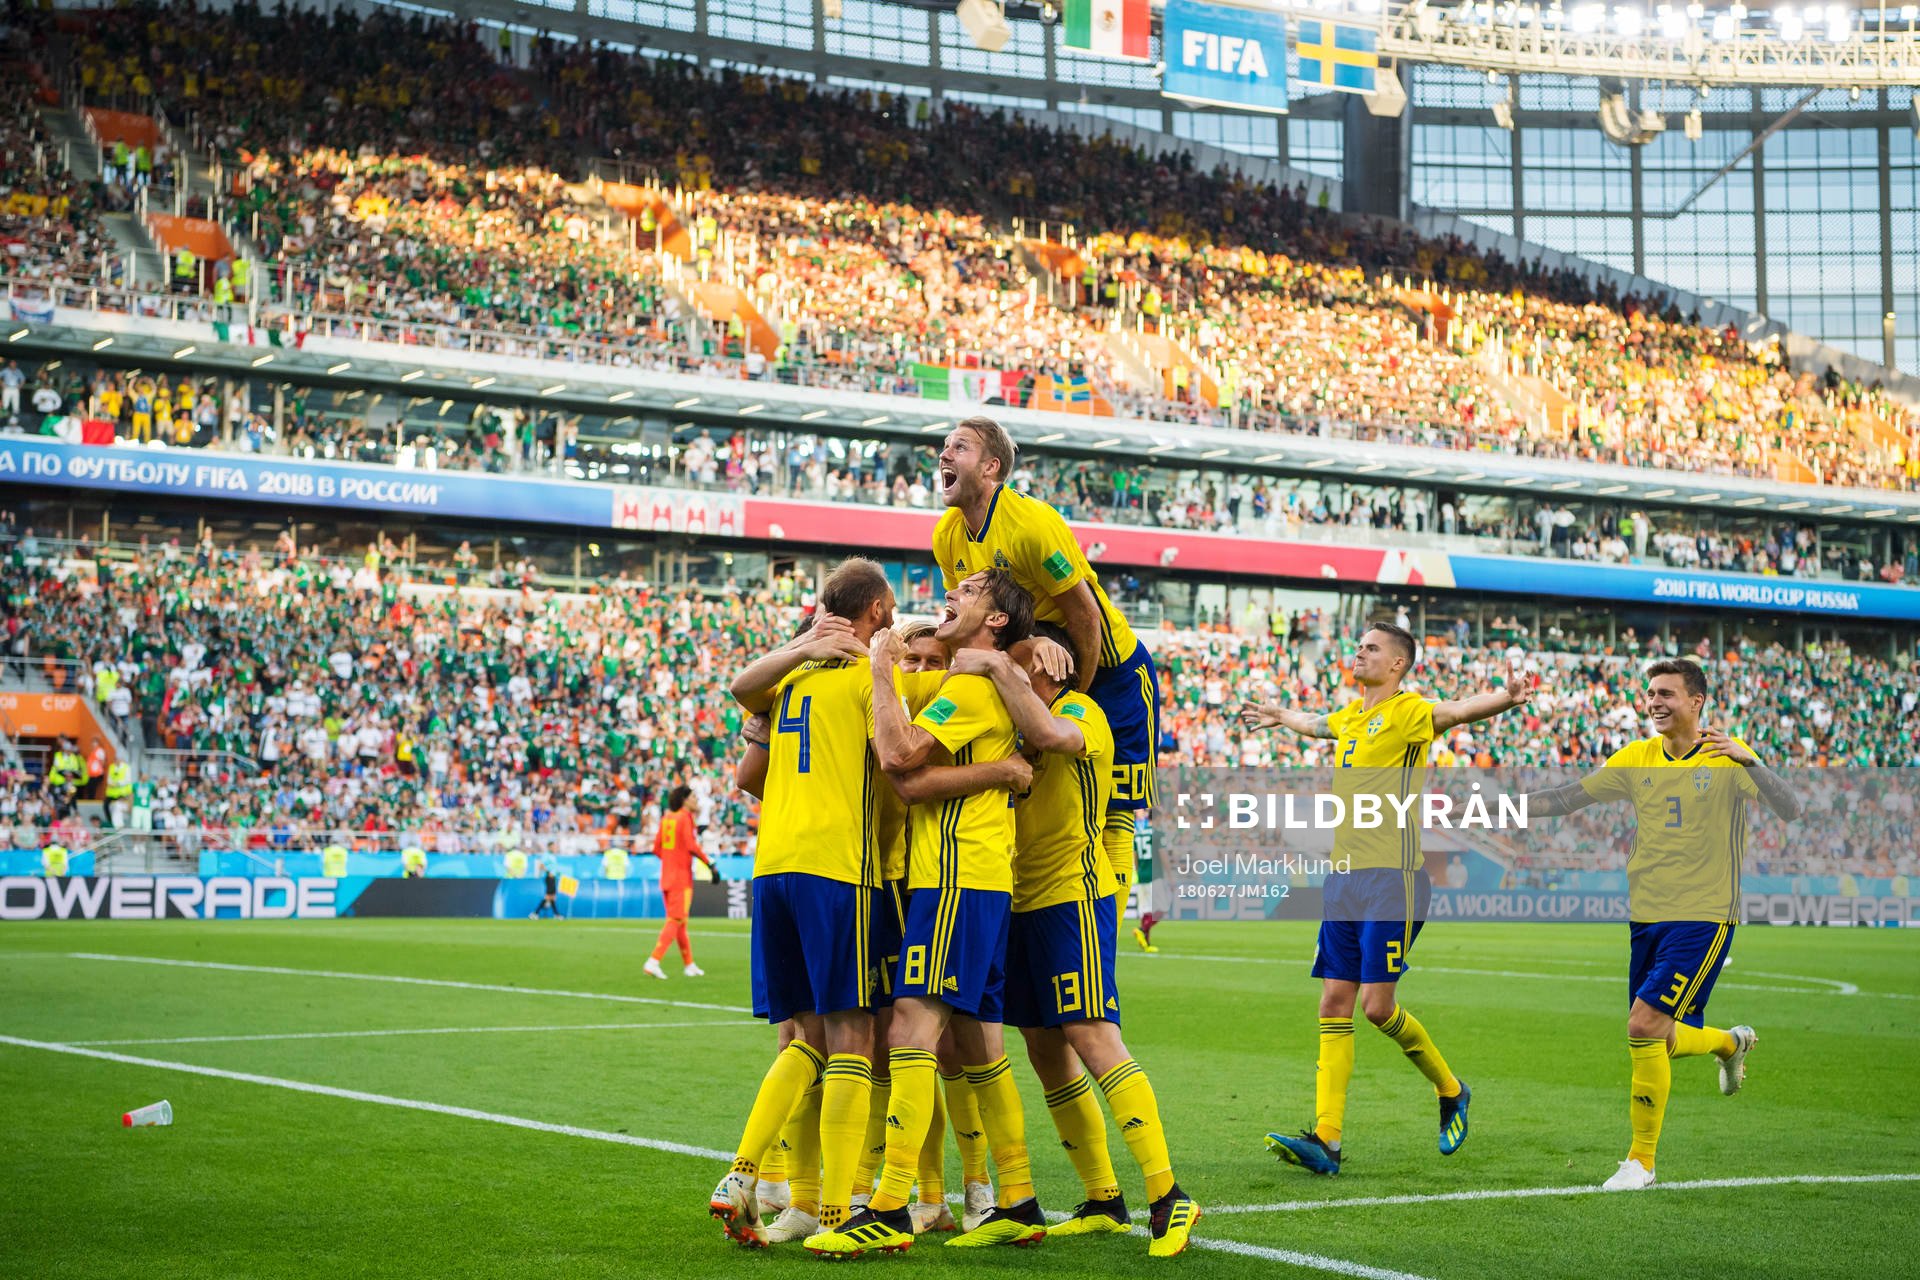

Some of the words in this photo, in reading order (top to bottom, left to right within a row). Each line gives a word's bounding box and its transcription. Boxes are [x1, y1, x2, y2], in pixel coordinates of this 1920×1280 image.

[1182, 29, 1269, 78] FIFA
[22, 451, 62, 476] ПО
[68, 456, 190, 486] ФУТБОЛУ
[195, 465, 249, 491] FIFA
[257, 470, 314, 497] 2018
[317, 475, 335, 497] В
[340, 477, 438, 505] РОССИИ
[1653, 577, 1687, 598] 2018
[1688, 580, 1720, 601] FIFA
[1720, 583, 1774, 603] WORLD
[1774, 588, 1804, 607] CUP
[1806, 590, 1859, 611] RUSSIA
[778, 684, 812, 773] 4
[1342, 739, 1357, 769] 2
[1111, 763, 1147, 800] 20
[1664, 796, 1682, 828] 3
[1135, 836, 1152, 860] 15
[1456, 894, 1534, 917] WORLD
[1536, 896, 1581, 919] CUP
[904, 945, 926, 985] 8
[1387, 941, 1401, 972] 2
[1051, 971, 1082, 1014] 13
[1660, 973, 1689, 1007] 3
